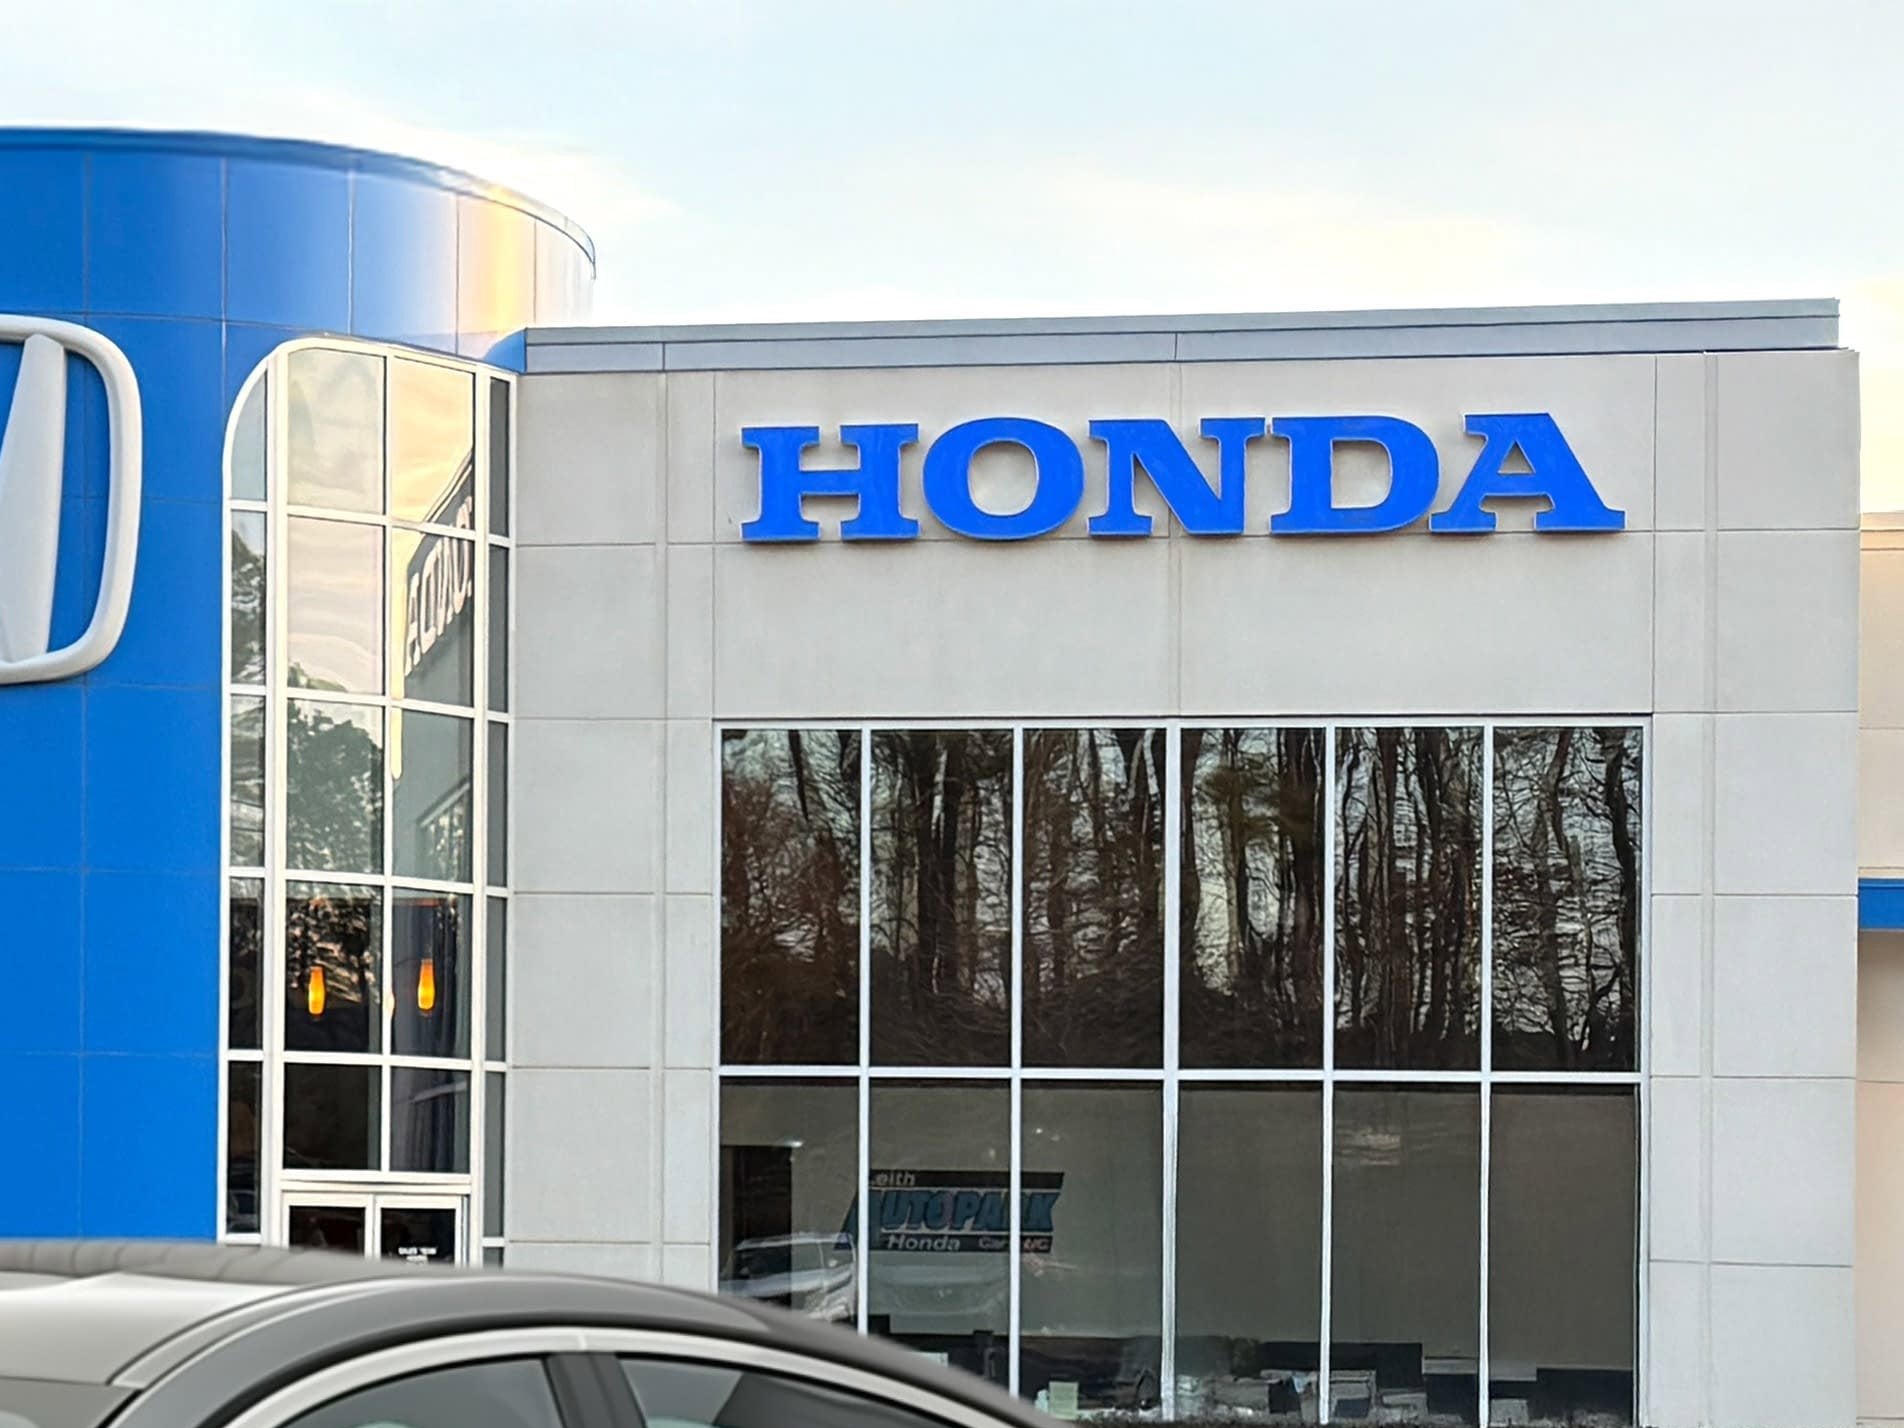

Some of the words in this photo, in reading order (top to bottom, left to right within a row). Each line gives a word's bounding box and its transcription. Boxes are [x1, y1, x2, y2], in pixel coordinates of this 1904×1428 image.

[740, 411, 1626, 542] HONDA
[870, 1172, 916, 1187] eith
[887, 1235, 961, 1251] Honda
